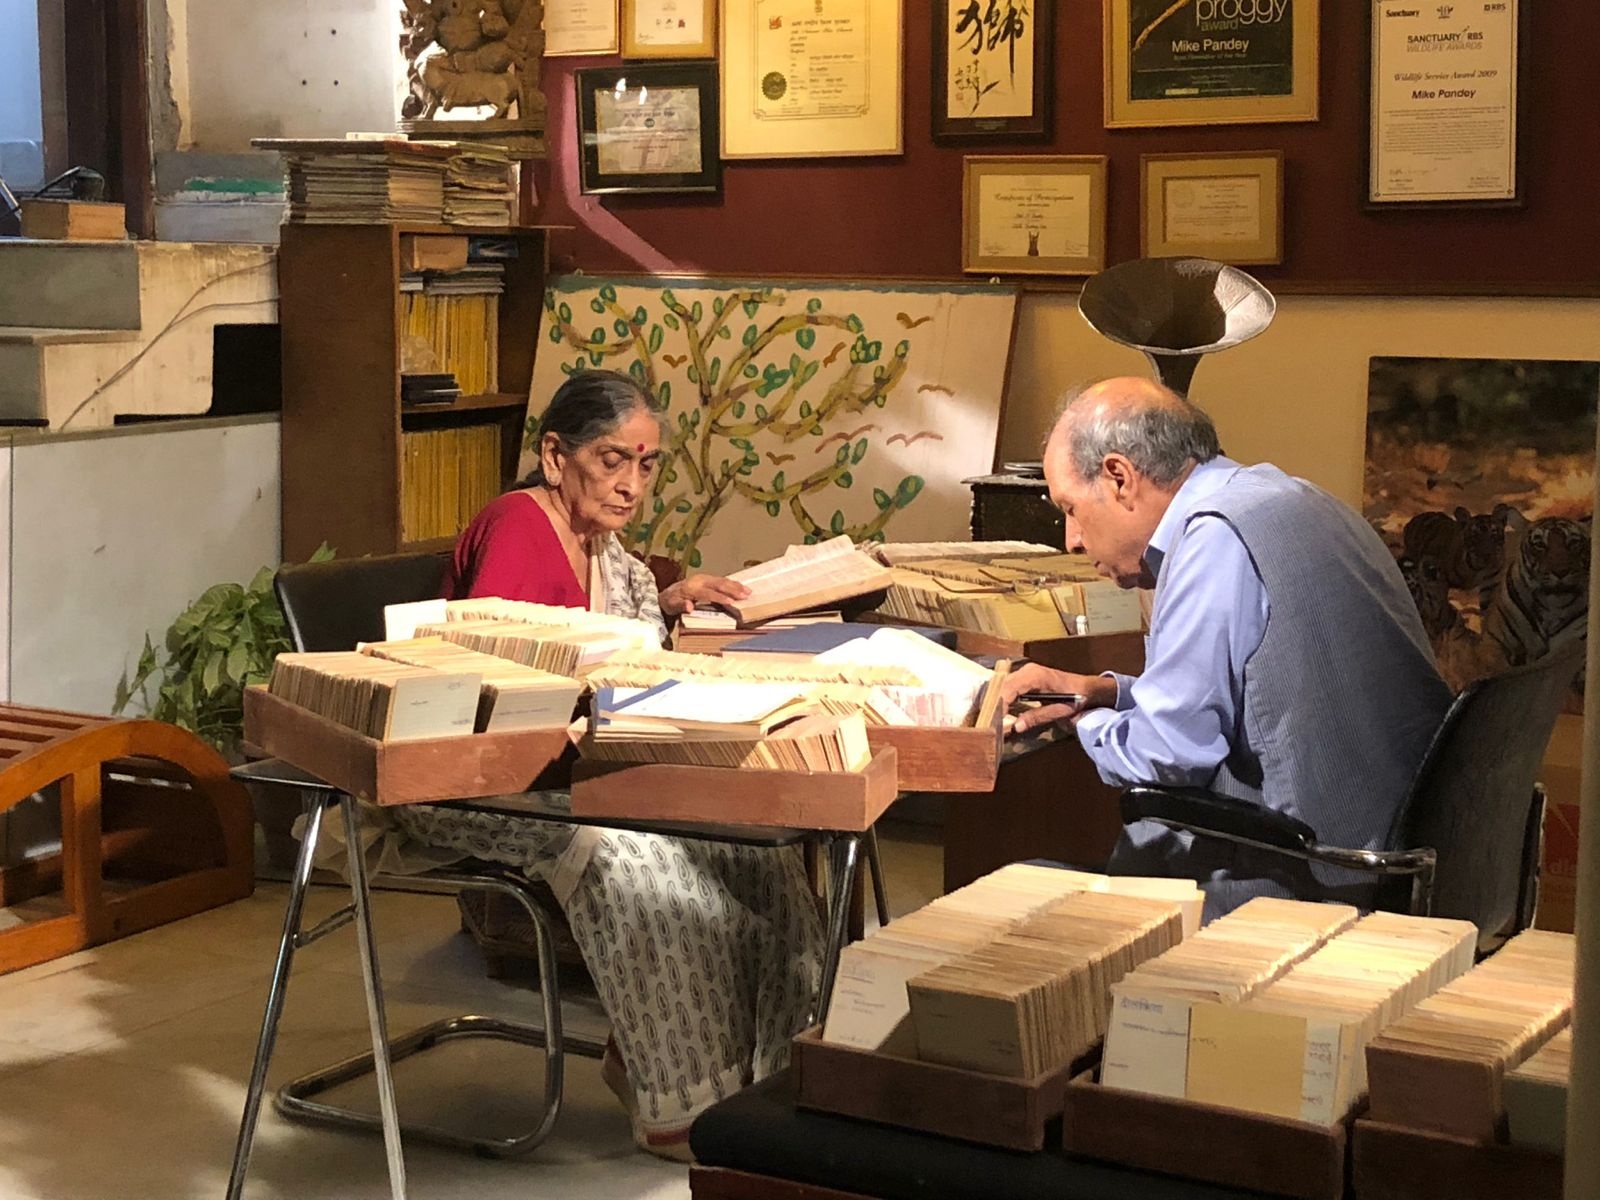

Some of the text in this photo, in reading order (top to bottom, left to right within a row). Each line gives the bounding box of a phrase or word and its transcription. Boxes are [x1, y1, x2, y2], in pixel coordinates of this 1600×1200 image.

[1196, 0, 1287, 26] proggy
[1386, 9, 1420, 18] Sanctuary
[1201, 18, 1239, 31] award
[1407, 31, 1484, 43] SANCTUARY RBS
[1172, 37, 1250, 53] Mike Pandey
[1407, 41, 1483, 53] WILDLIFE AWARDS
[1411, 88, 1477, 99] Mike Pandey
